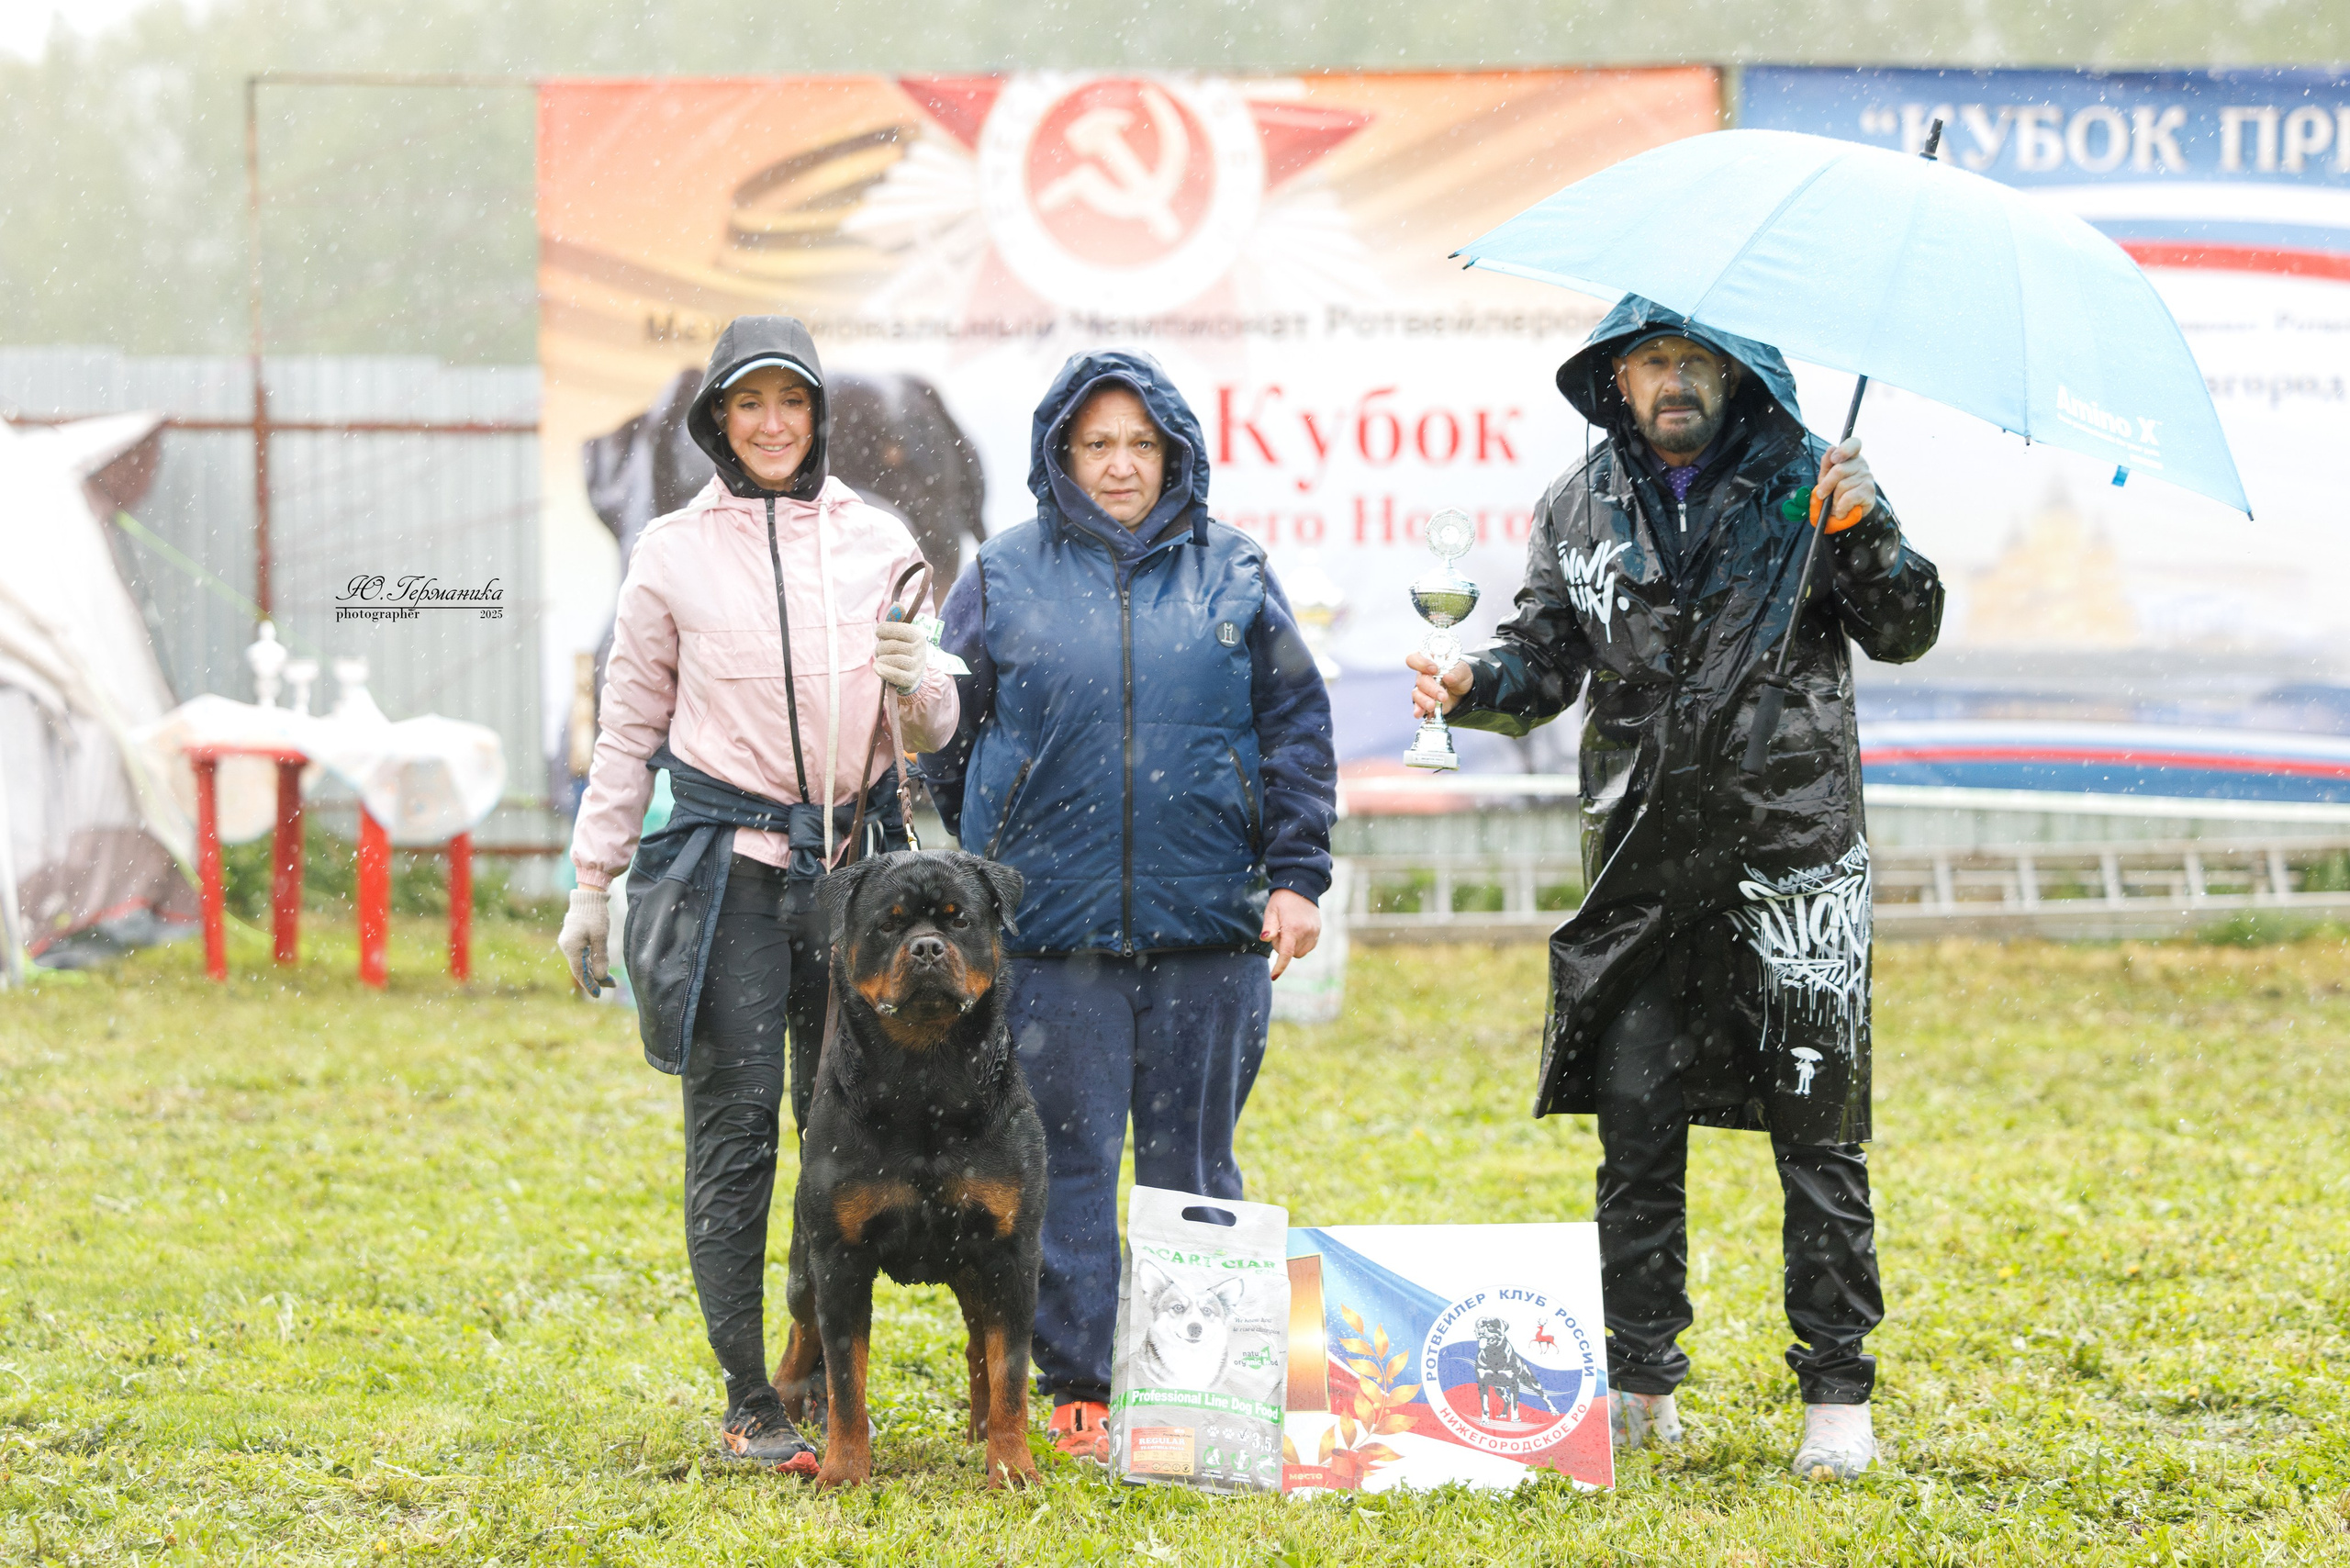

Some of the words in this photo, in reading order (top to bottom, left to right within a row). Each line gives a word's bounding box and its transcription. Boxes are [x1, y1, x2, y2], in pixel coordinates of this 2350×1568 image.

[2056, 385, 2132, 438] Amino
[1212, 384, 1524, 493] Кубок
[1426, 1293, 1486, 1382] РОТВЕЙЛЕР
[1499, 1289, 1547, 1307] КЛУБ
[1554, 1307, 1595, 1377] РОССИИ
[1131, 1390, 1202, 1406] Professional
[1203, 1393, 1229, 1408] Line
[1231, 1397, 1253, 1415] Dog
[1255, 1402, 1279, 1419] Food
[1439, 1406, 1572, 1451] НИЖЕГОРОДСКОЕ
[1571, 1404, 1587, 1422] РО
[1138, 1437, 1185, 1445] REGULAR
[1251, 1432, 1272, 1452] 3,5
